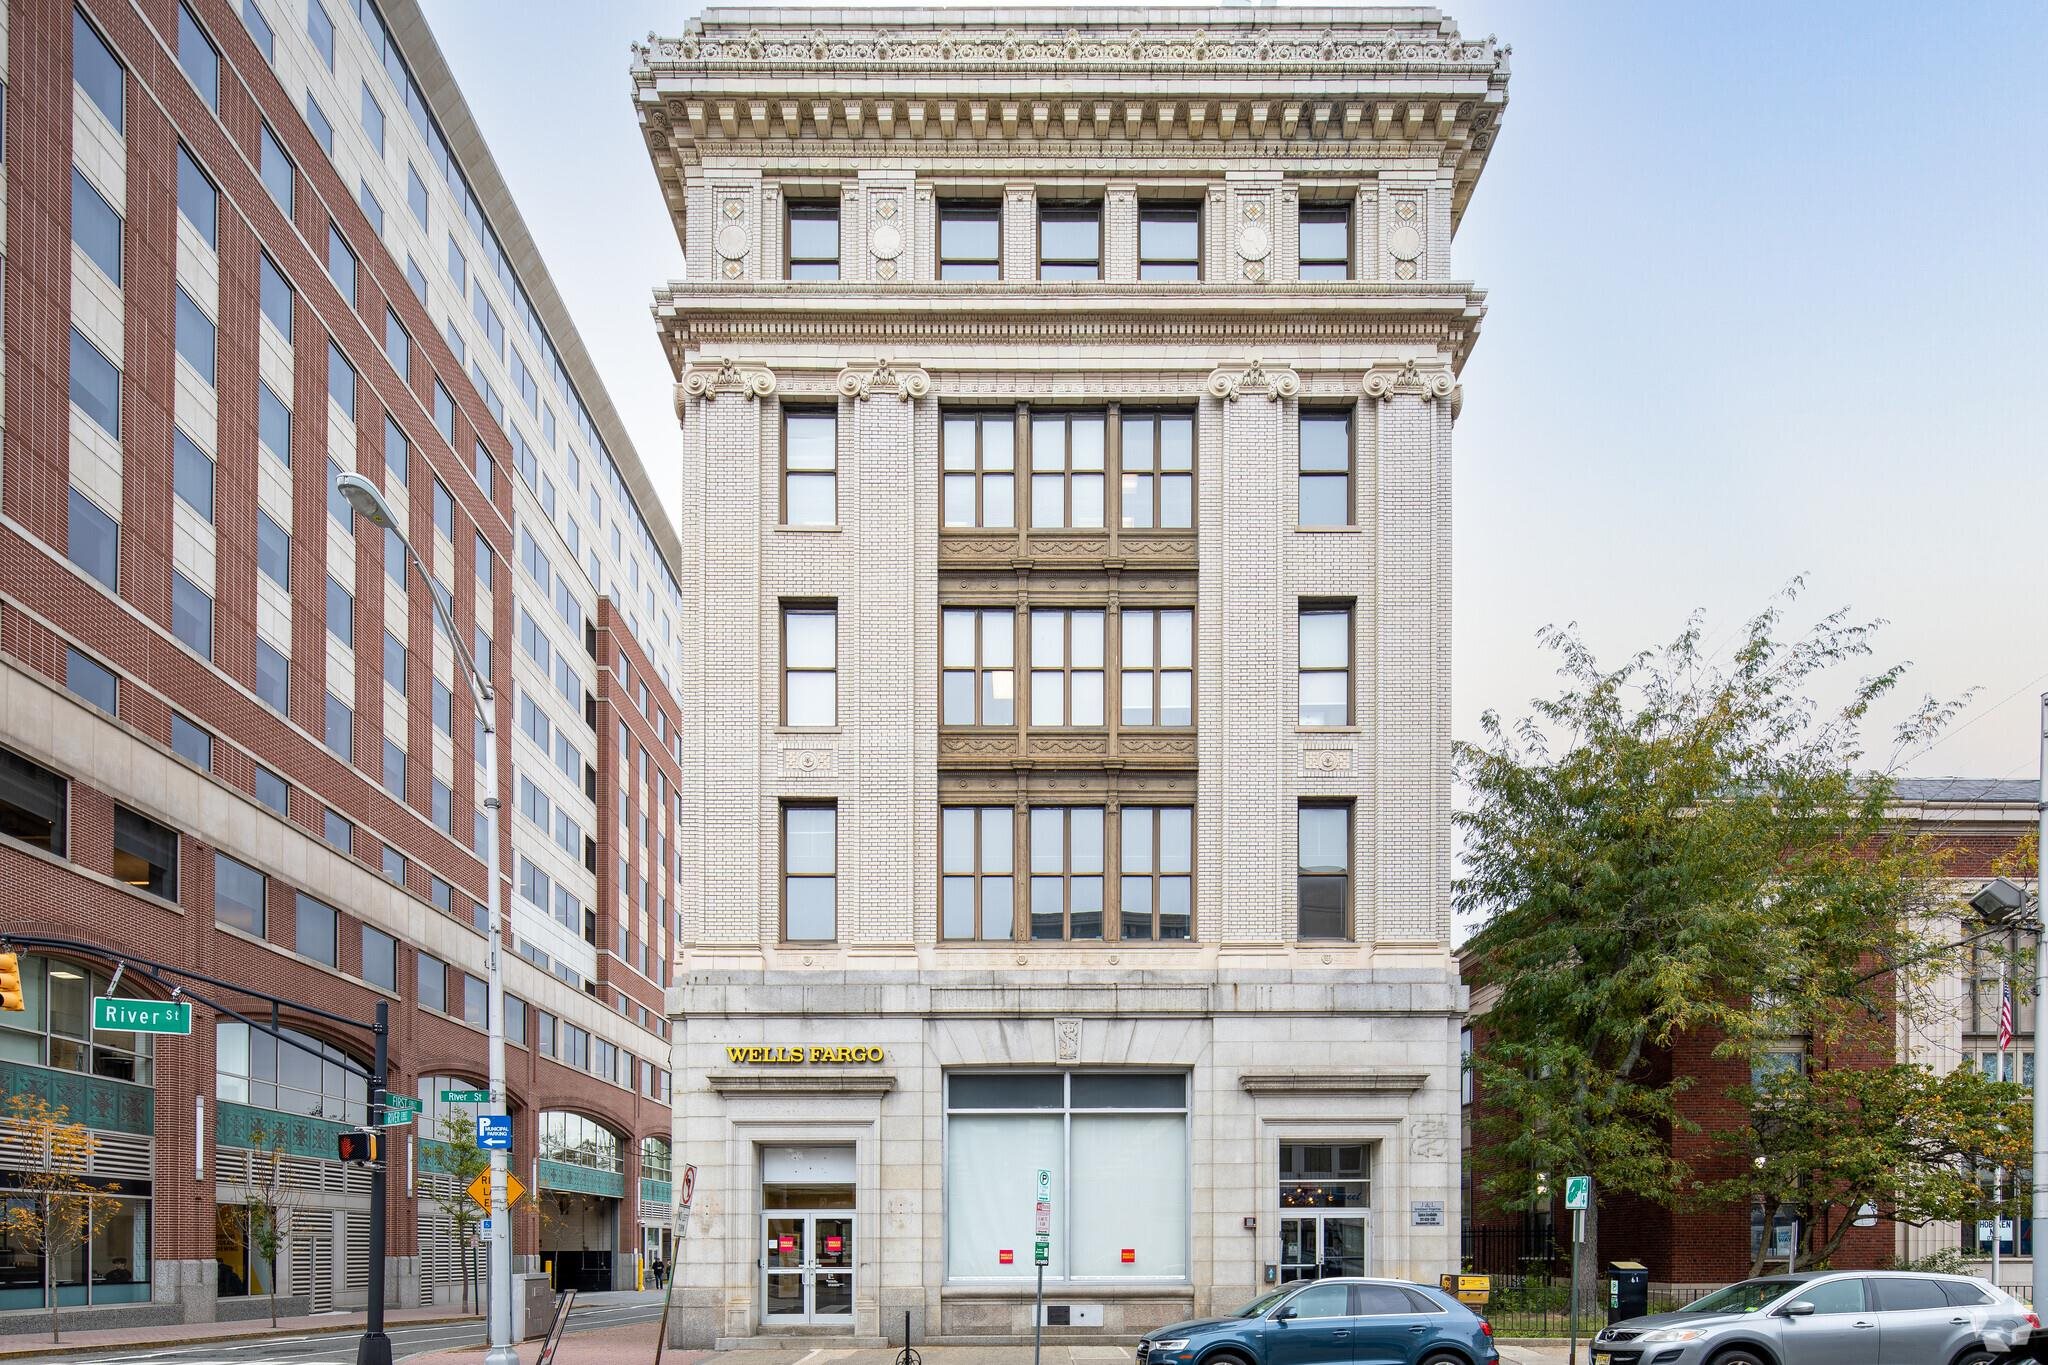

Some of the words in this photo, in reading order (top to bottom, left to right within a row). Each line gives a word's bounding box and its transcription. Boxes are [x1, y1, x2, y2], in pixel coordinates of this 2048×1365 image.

[106, 1005, 159, 1024] River
[165, 1010, 179, 1021] St
[727, 1046, 804, 1063] WELLS
[808, 1046, 884, 1063] FARGO
[392, 1096, 407, 1109] FIRST
[448, 1092, 467, 1101] River
[474, 1093, 482, 1102] St
[387, 1111, 400, 1124] RIVER
[479, 1117, 491, 1136] P
[1582, 1178, 1587, 1190] 2
[1979, 1220, 2011, 1229] HOBEN
